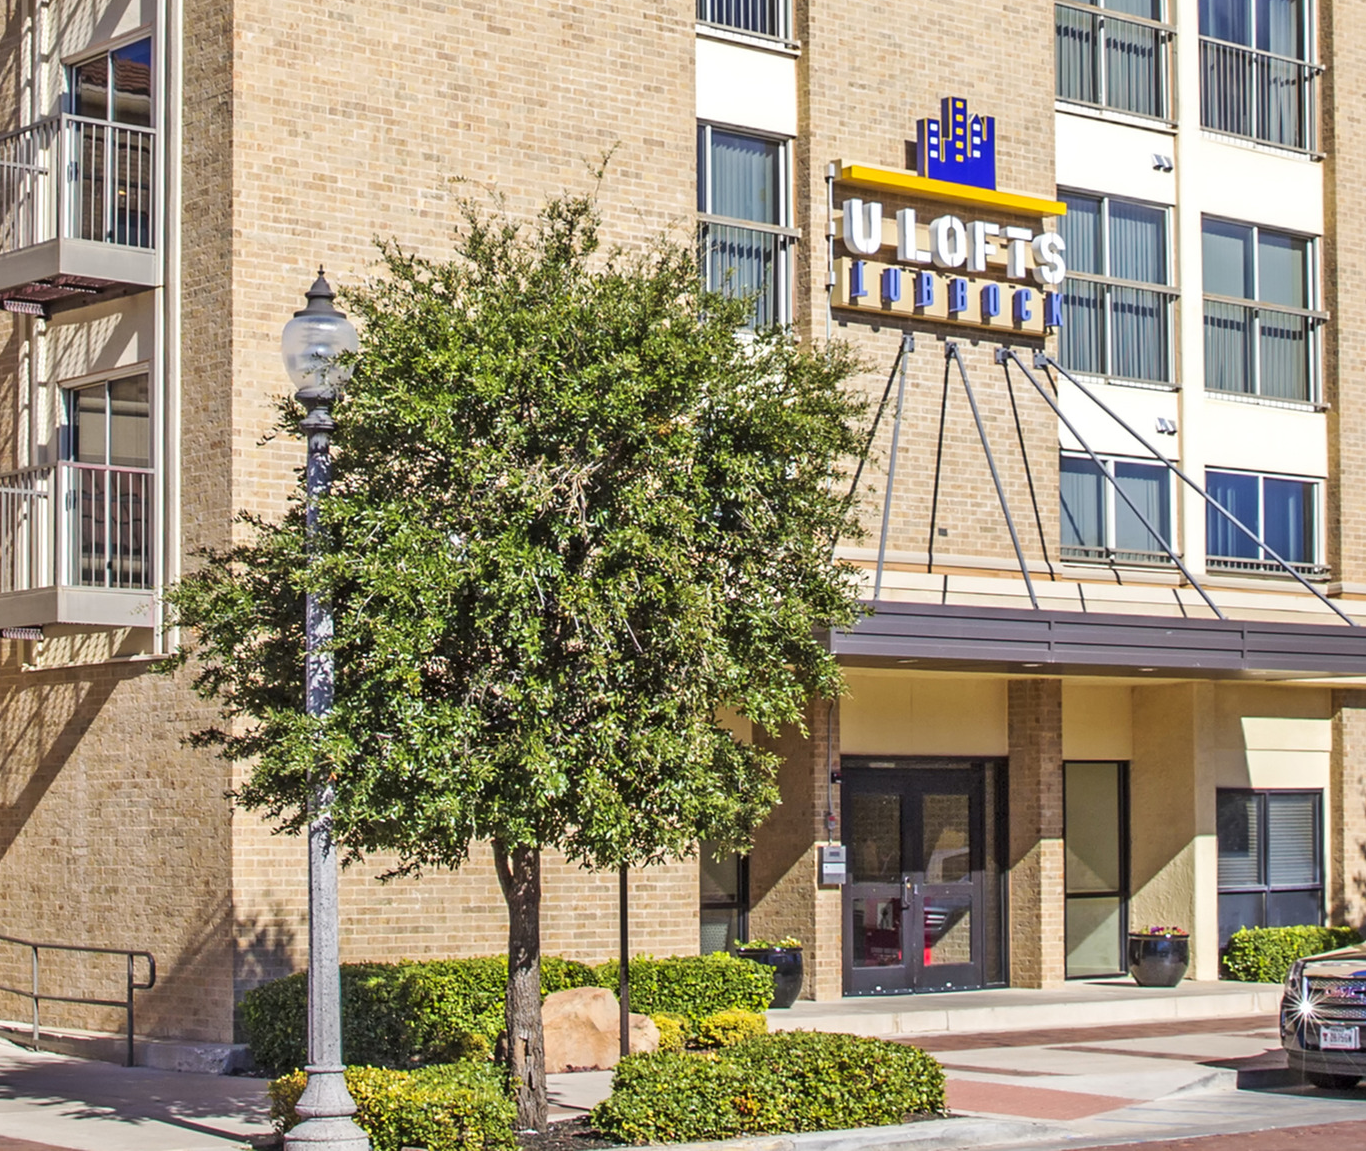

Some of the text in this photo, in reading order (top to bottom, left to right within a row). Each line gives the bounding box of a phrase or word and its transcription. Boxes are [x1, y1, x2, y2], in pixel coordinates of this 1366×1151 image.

[843, 199, 1066, 284] U LOFTS
[851, 260, 1063, 327] LUBBOCK
